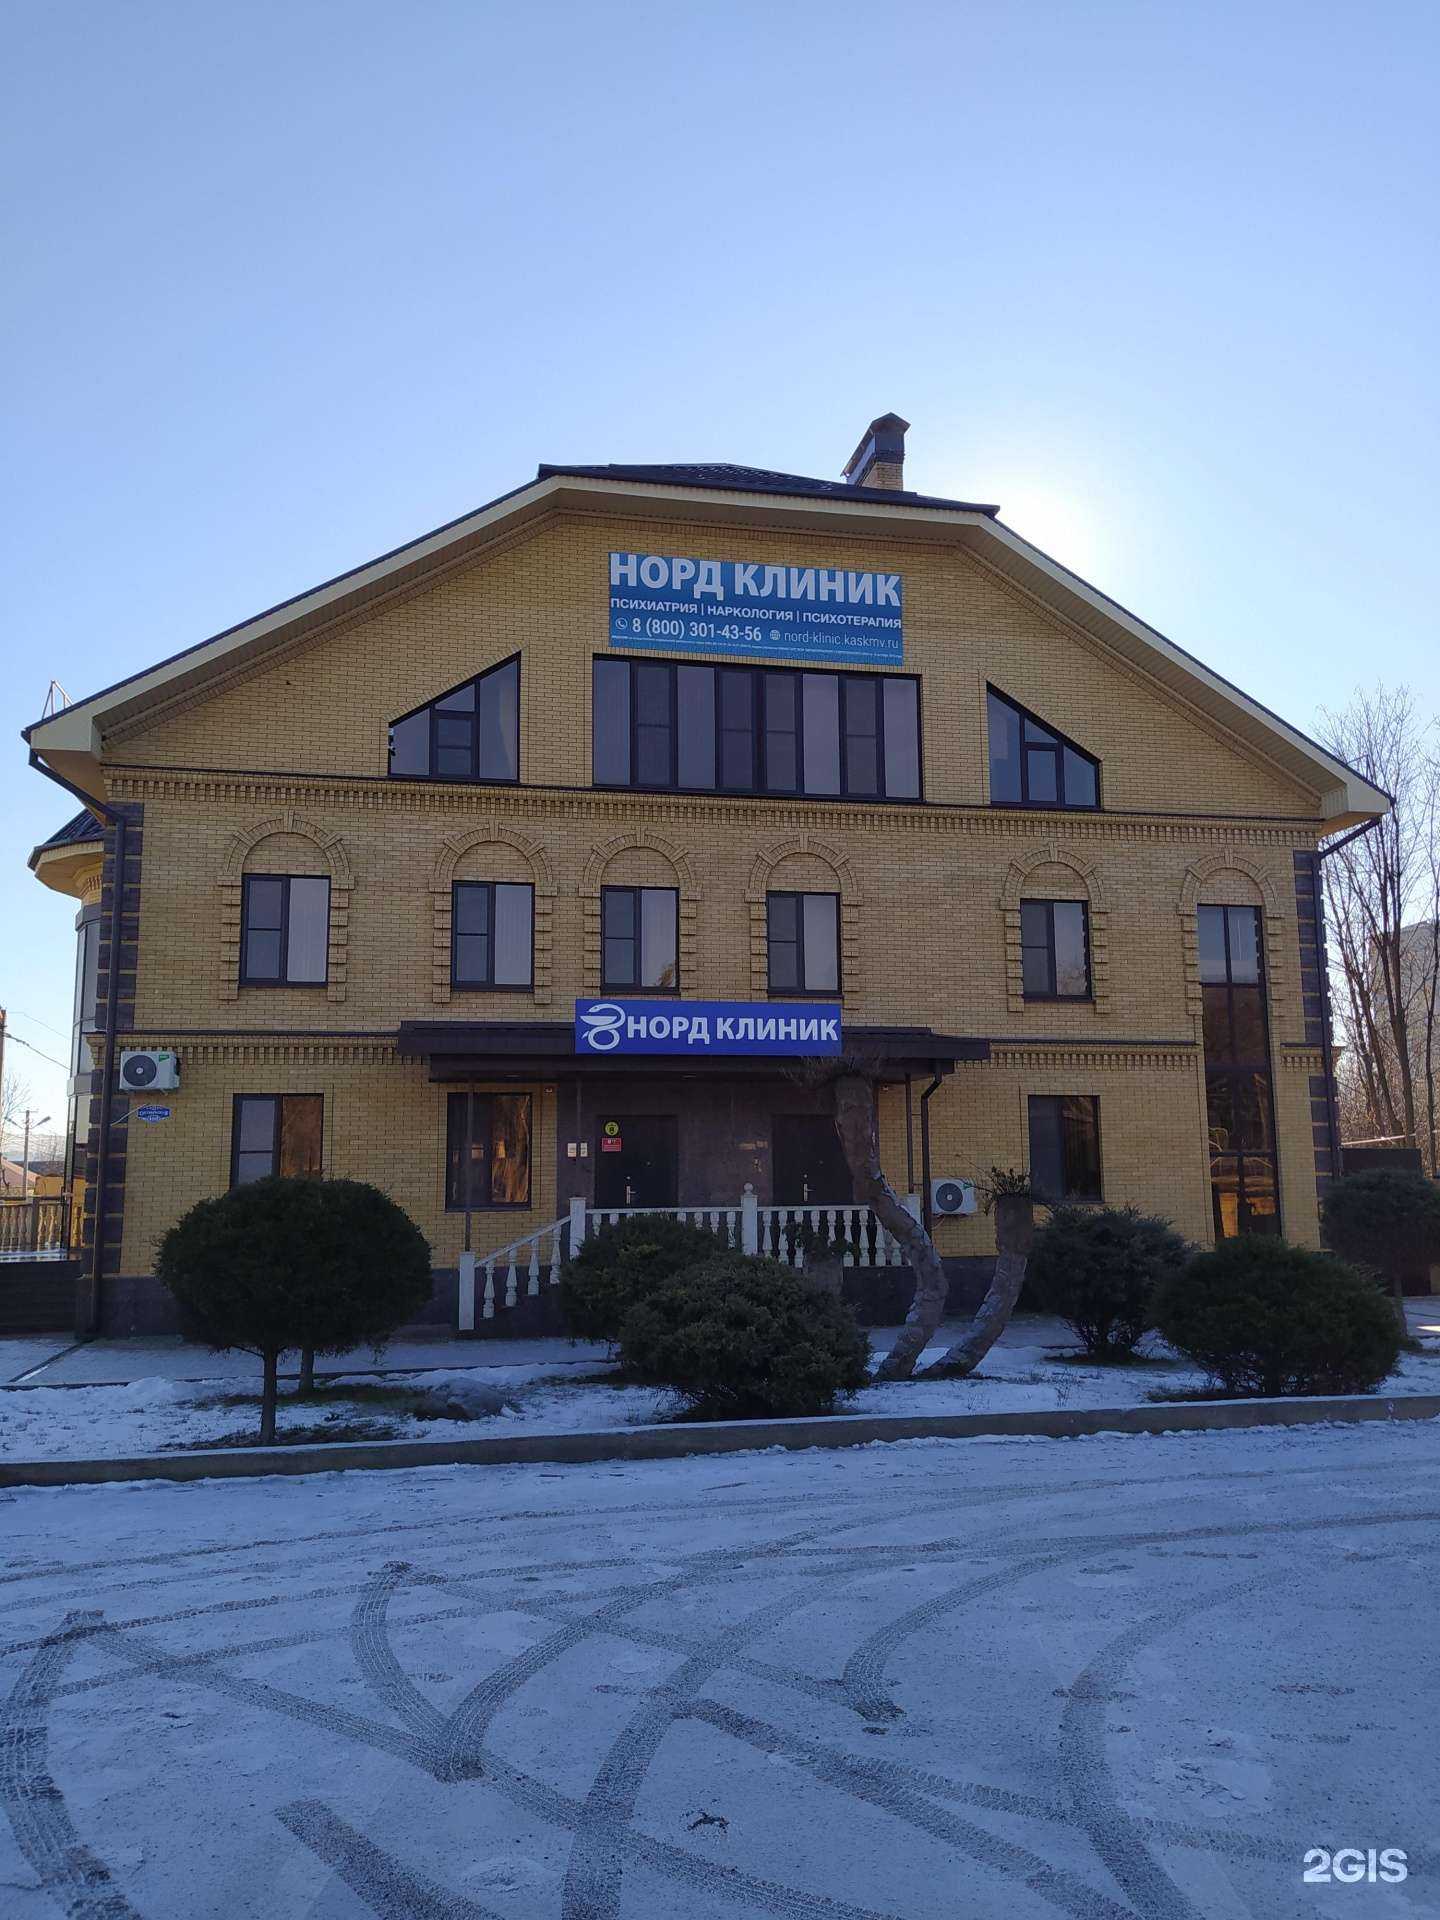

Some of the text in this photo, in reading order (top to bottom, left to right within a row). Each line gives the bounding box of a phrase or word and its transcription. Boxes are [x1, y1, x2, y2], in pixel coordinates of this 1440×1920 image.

[610, 552, 901, 607] НОРД КЛИНИК
[610, 598, 902, 629] ПСИХИАТРИЯ НАРКОЛОГИЯ ПСИХОТЕРАПИЯ
[632, 617, 762, 642] 8 (800) 301-43-56
[784, 631, 899, 649] nord-klinic.kaskmv.ru
[627, 1015, 839, 1044] НОРД КЛИНИК
